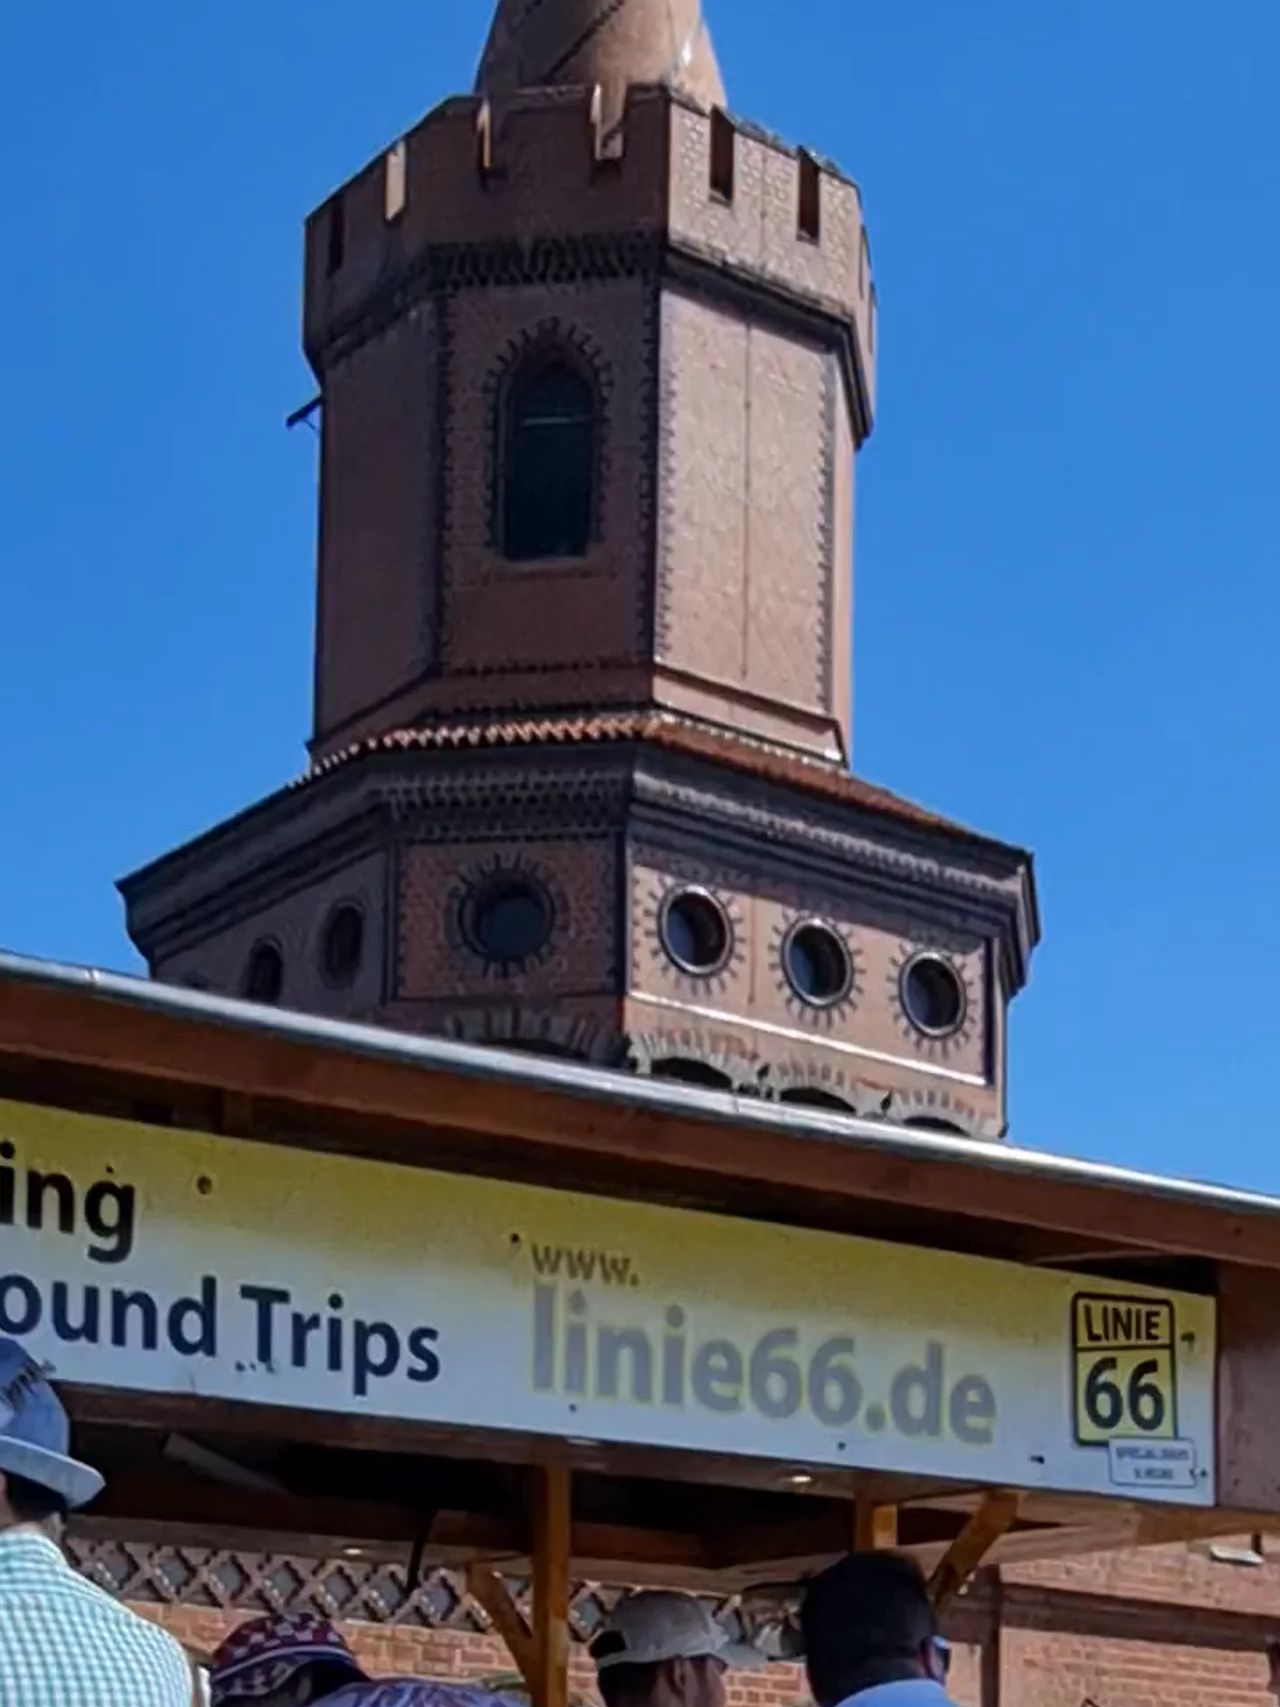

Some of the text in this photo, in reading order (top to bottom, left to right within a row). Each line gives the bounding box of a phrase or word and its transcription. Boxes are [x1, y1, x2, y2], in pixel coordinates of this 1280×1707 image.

[531, 1242, 640, 1287] www.
[239, 1282, 442, 1397] Trips
[1083, 1303, 1162, 1342] LINIE
[532, 1286, 997, 1443] linie66.de
[1084, 1356, 1165, 1432] 66
